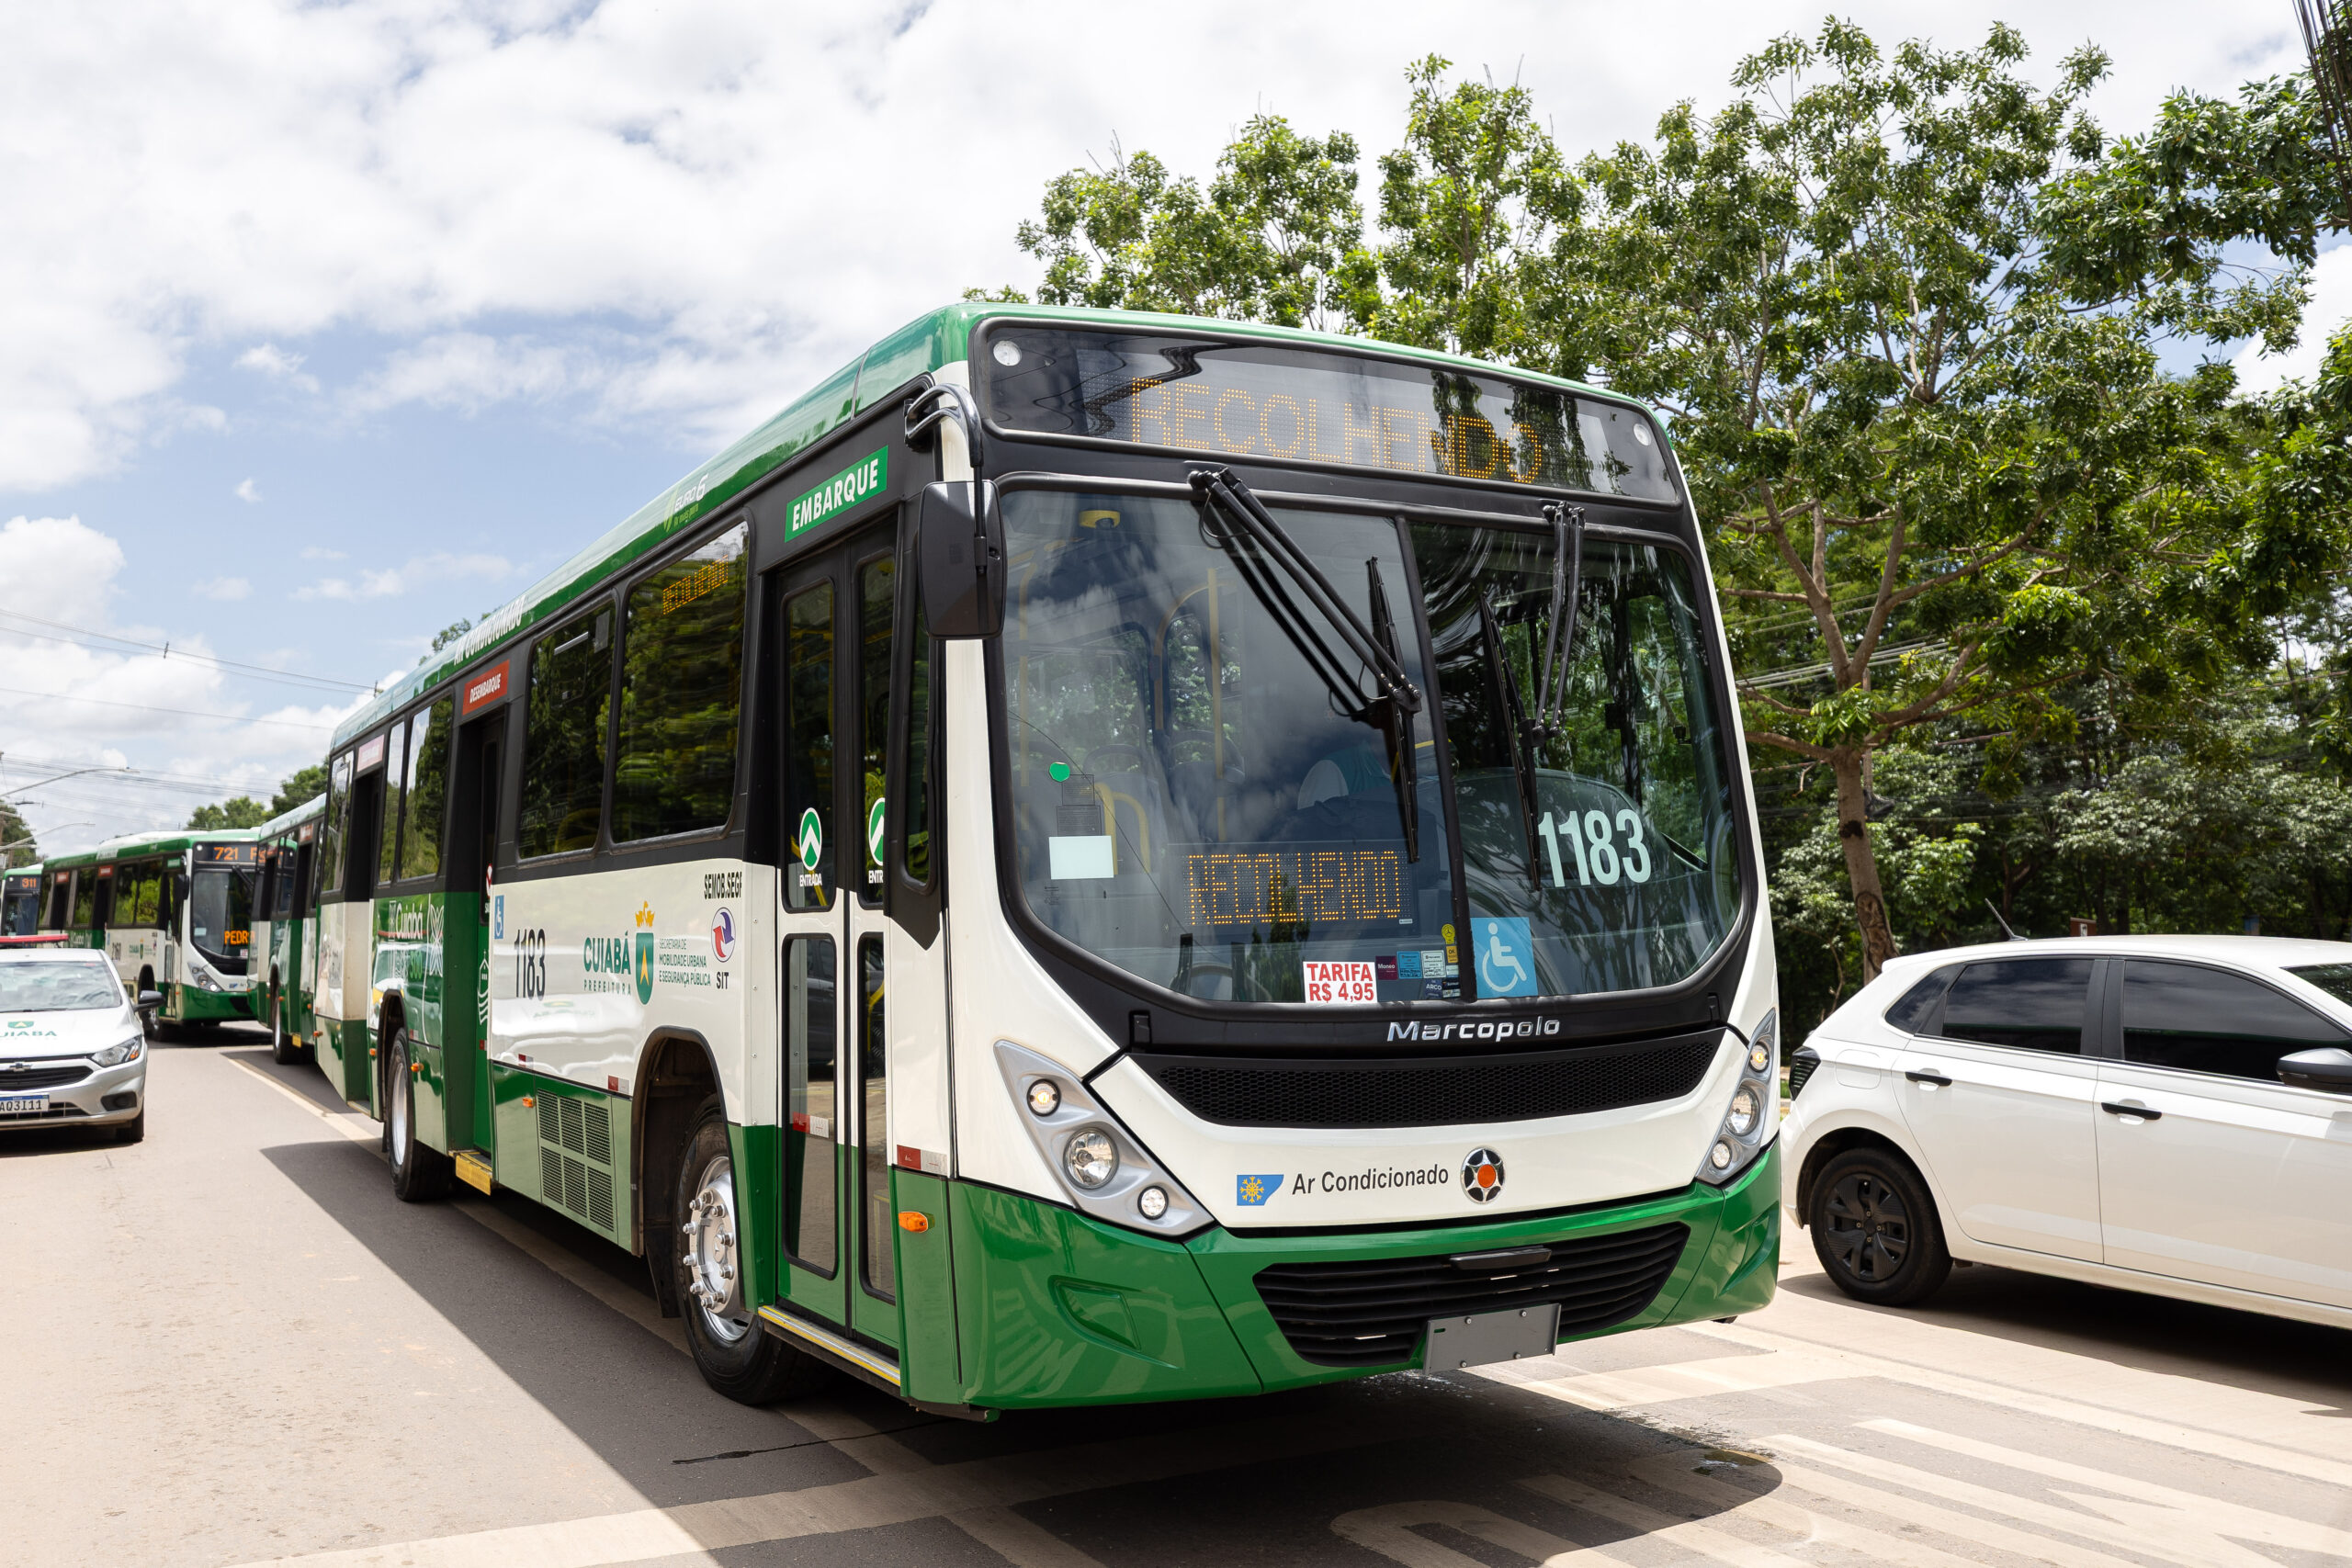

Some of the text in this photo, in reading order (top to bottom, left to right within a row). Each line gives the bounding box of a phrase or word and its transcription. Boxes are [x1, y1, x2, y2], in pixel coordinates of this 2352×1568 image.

[1132, 377, 1543, 485] RECOLHENDO
[792, 458, 878, 532] EMBARQUE
[662, 554, 728, 615] RECOLHENDO
[469, 673, 502, 704] DESEMBARQUE
[213, 847, 238, 860] 721
[1538, 808, 1651, 887] 1183
[799, 873, 822, 886] ENTRADA
[1189, 851, 1401, 925] RECOLHENDO
[514, 929, 546, 1001] 1183
[583, 930, 631, 975] CUIABÁ
[659, 953, 707, 968] MOBILIDADE URBANA
[583, 979, 631, 995] PREFEITURA
[662, 970, 689, 987] SEGURANÇA
[690, 968, 711, 986] PÚBLICA
[716, 972, 729, 989] SIT
[1306, 964, 1374, 982] TARIFA
[1308, 982, 1374, 1003] R$ 4,95
[1386, 1015, 1560, 1042] Marcopolo
[1292, 1164, 1449, 1195] Ar Condicionado
